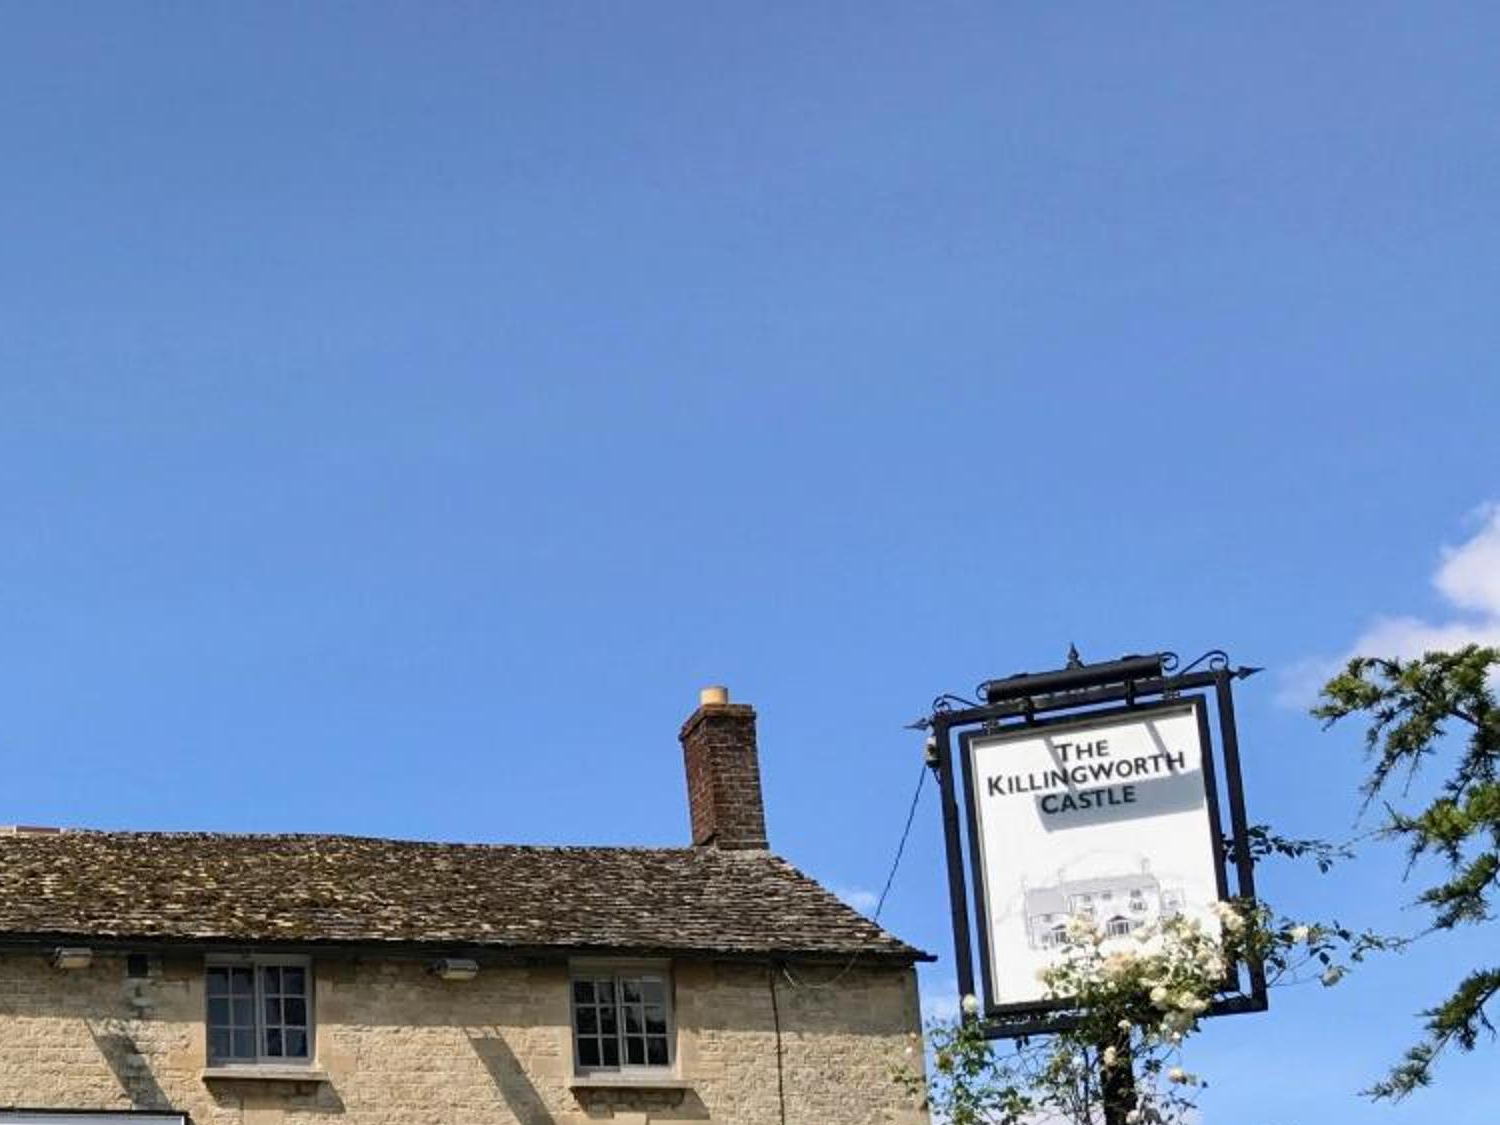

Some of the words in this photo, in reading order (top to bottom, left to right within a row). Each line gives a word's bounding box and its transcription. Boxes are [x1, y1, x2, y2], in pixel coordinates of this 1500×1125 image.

[1053, 740, 1109, 763] THE
[986, 751, 1185, 797] KILLINGWORTH
[1040, 784, 1137, 815] CASTLE
